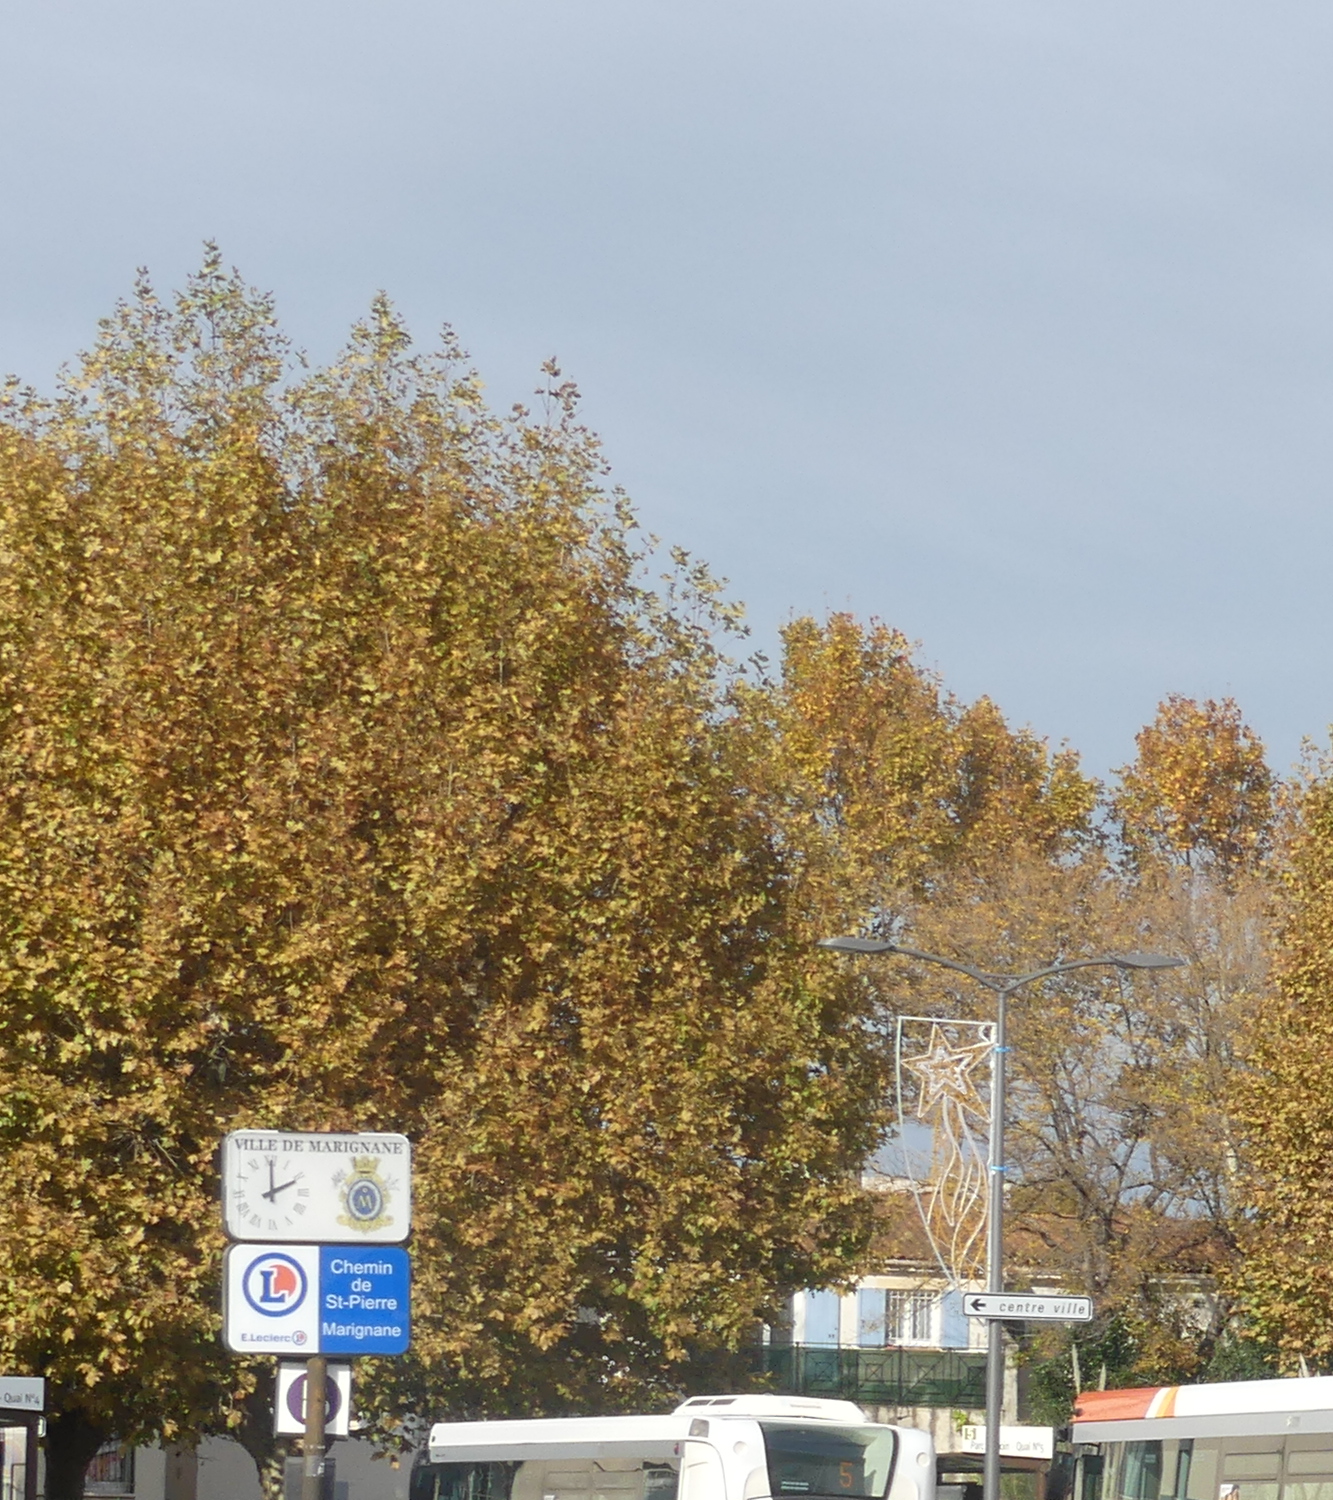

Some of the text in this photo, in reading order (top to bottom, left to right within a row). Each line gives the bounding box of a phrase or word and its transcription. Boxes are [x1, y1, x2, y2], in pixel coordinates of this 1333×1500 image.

[235, 1138, 403, 1155] VILLE DE MARIGNANE
[331, 1259, 393, 1275] Chemin
[351, 1278, 372, 1292] de
[325, 1295, 398, 1311] St-Pierre
[999, 1302, 1086, 1315] centre ville
[241, 1333, 291, 1343] E.Leclerc
[322, 1322, 402, 1340] Marignane
[840, 1462, 853, 1488] 5
